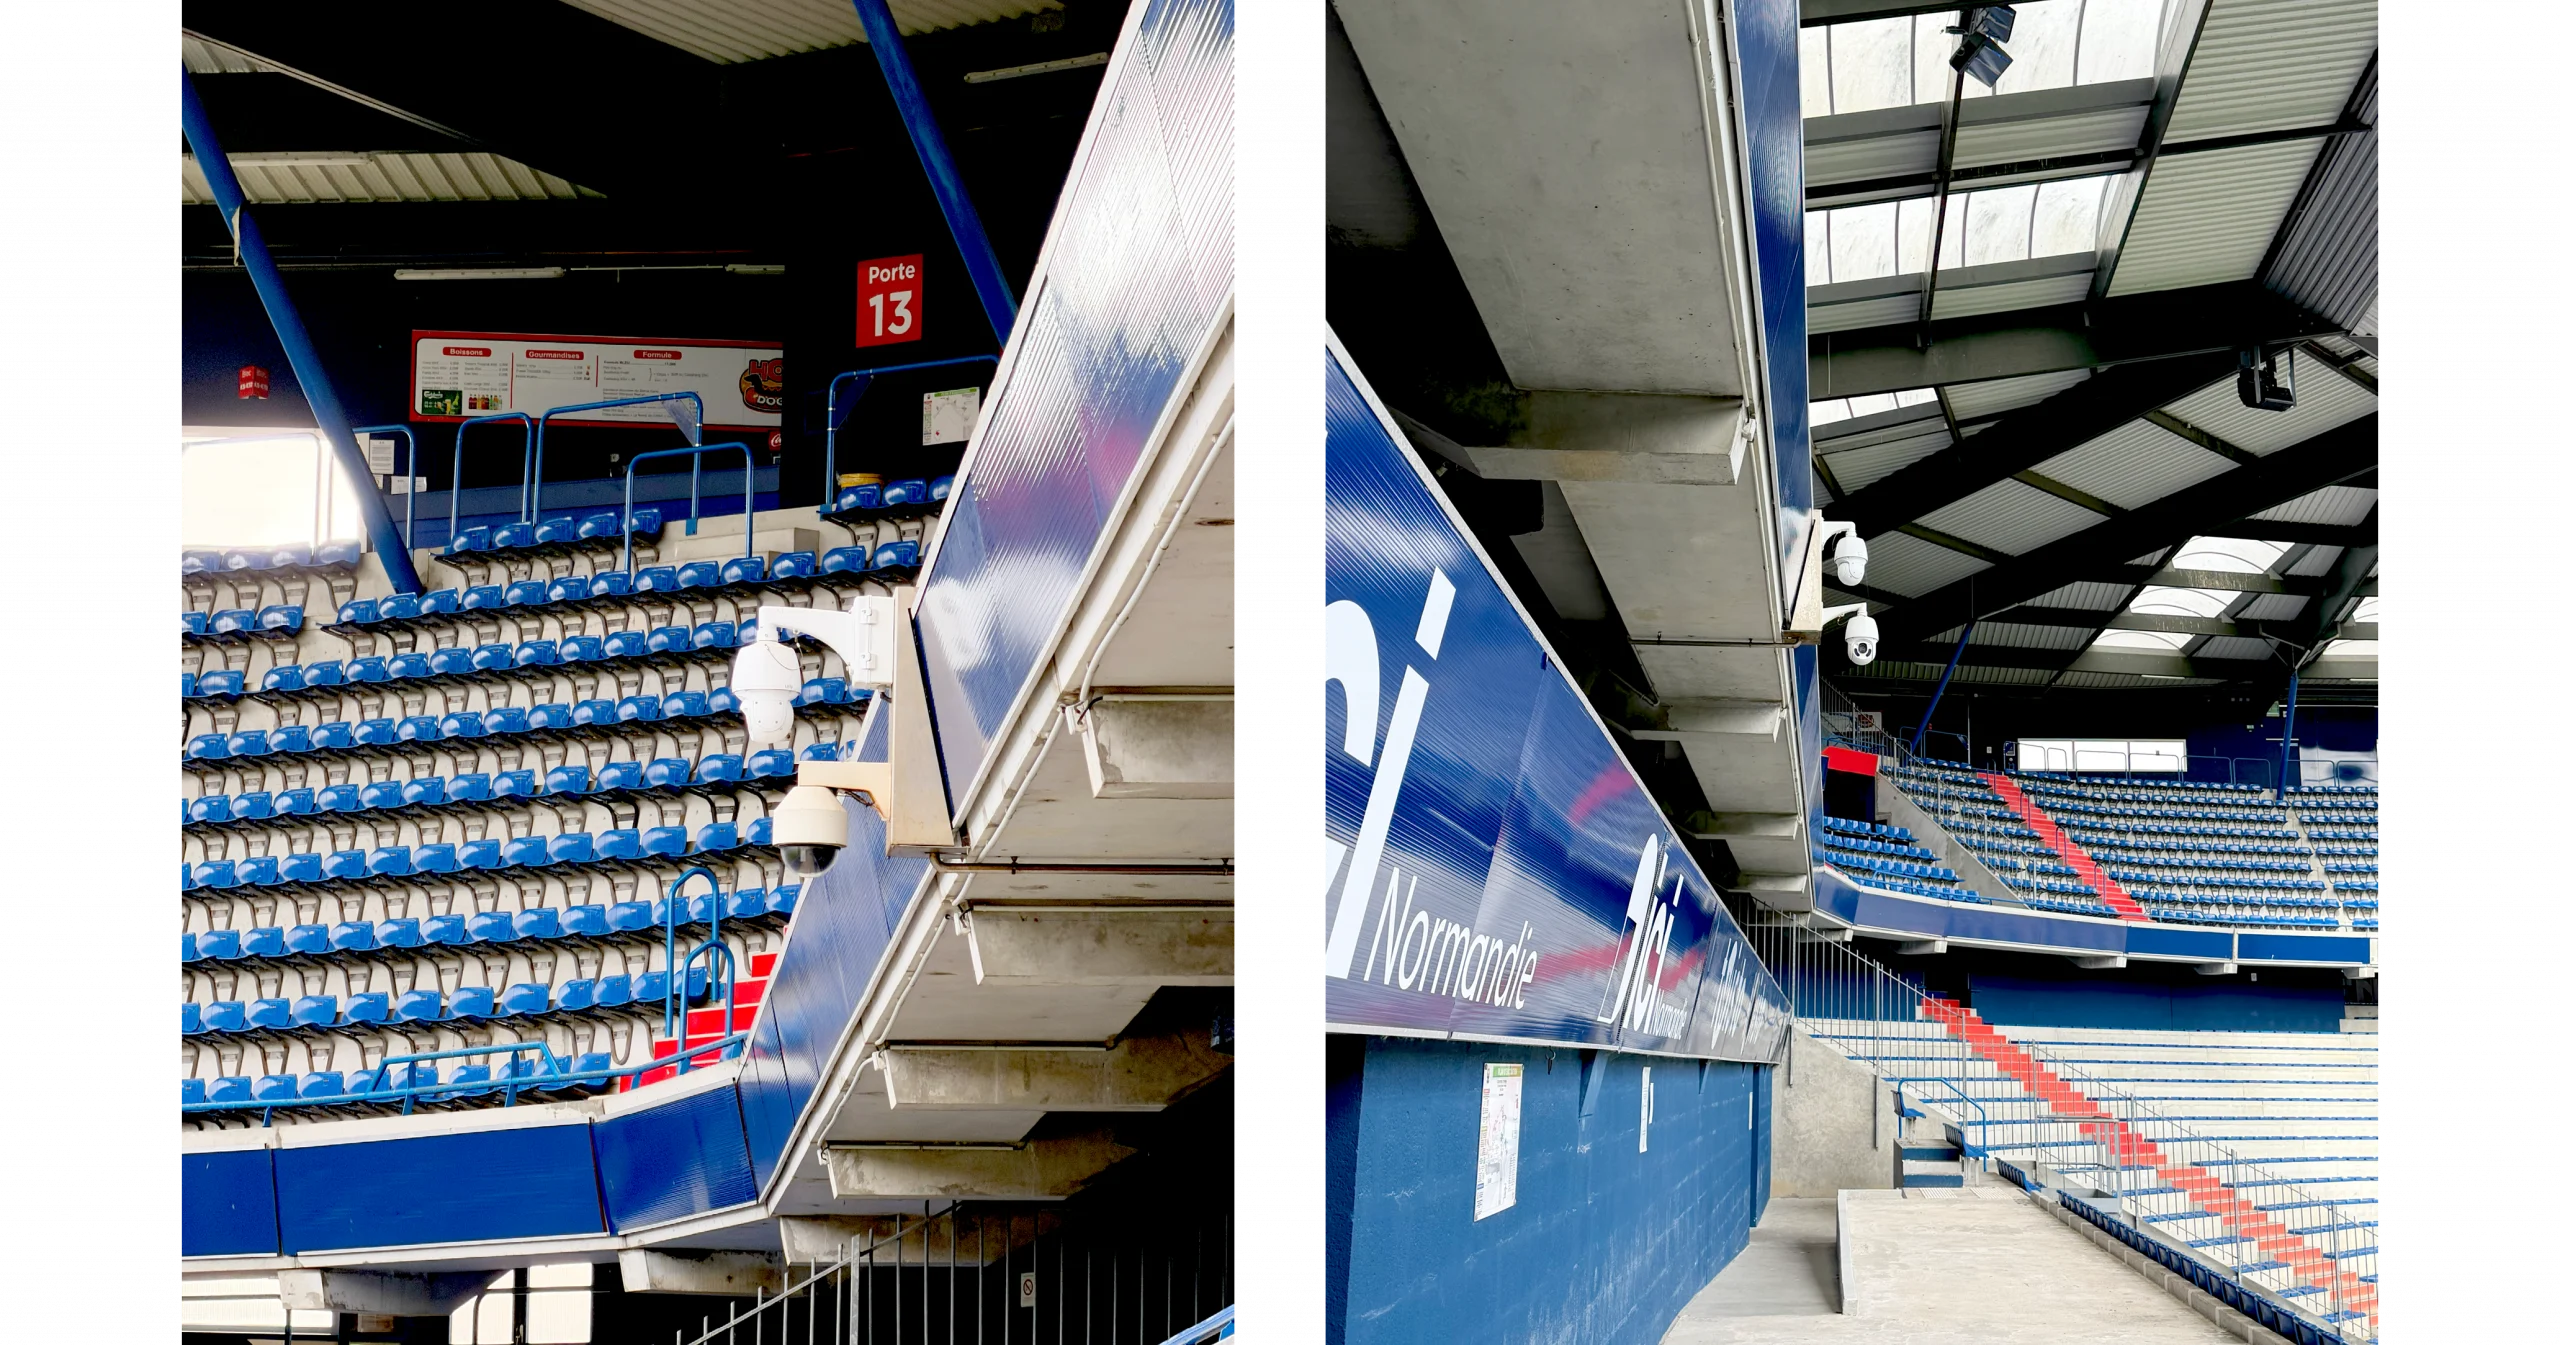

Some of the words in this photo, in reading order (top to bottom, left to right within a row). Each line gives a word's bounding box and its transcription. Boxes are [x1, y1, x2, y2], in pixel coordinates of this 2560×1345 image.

[868, 263, 916, 285] Porte
[868, 289, 913, 338] 13
[449, 348, 484, 356] Boissons
[528, 351, 580, 359] Gourmandises
[642, 351, 673, 359] Formule
[1363, 866, 1538, 1011] Normandie
